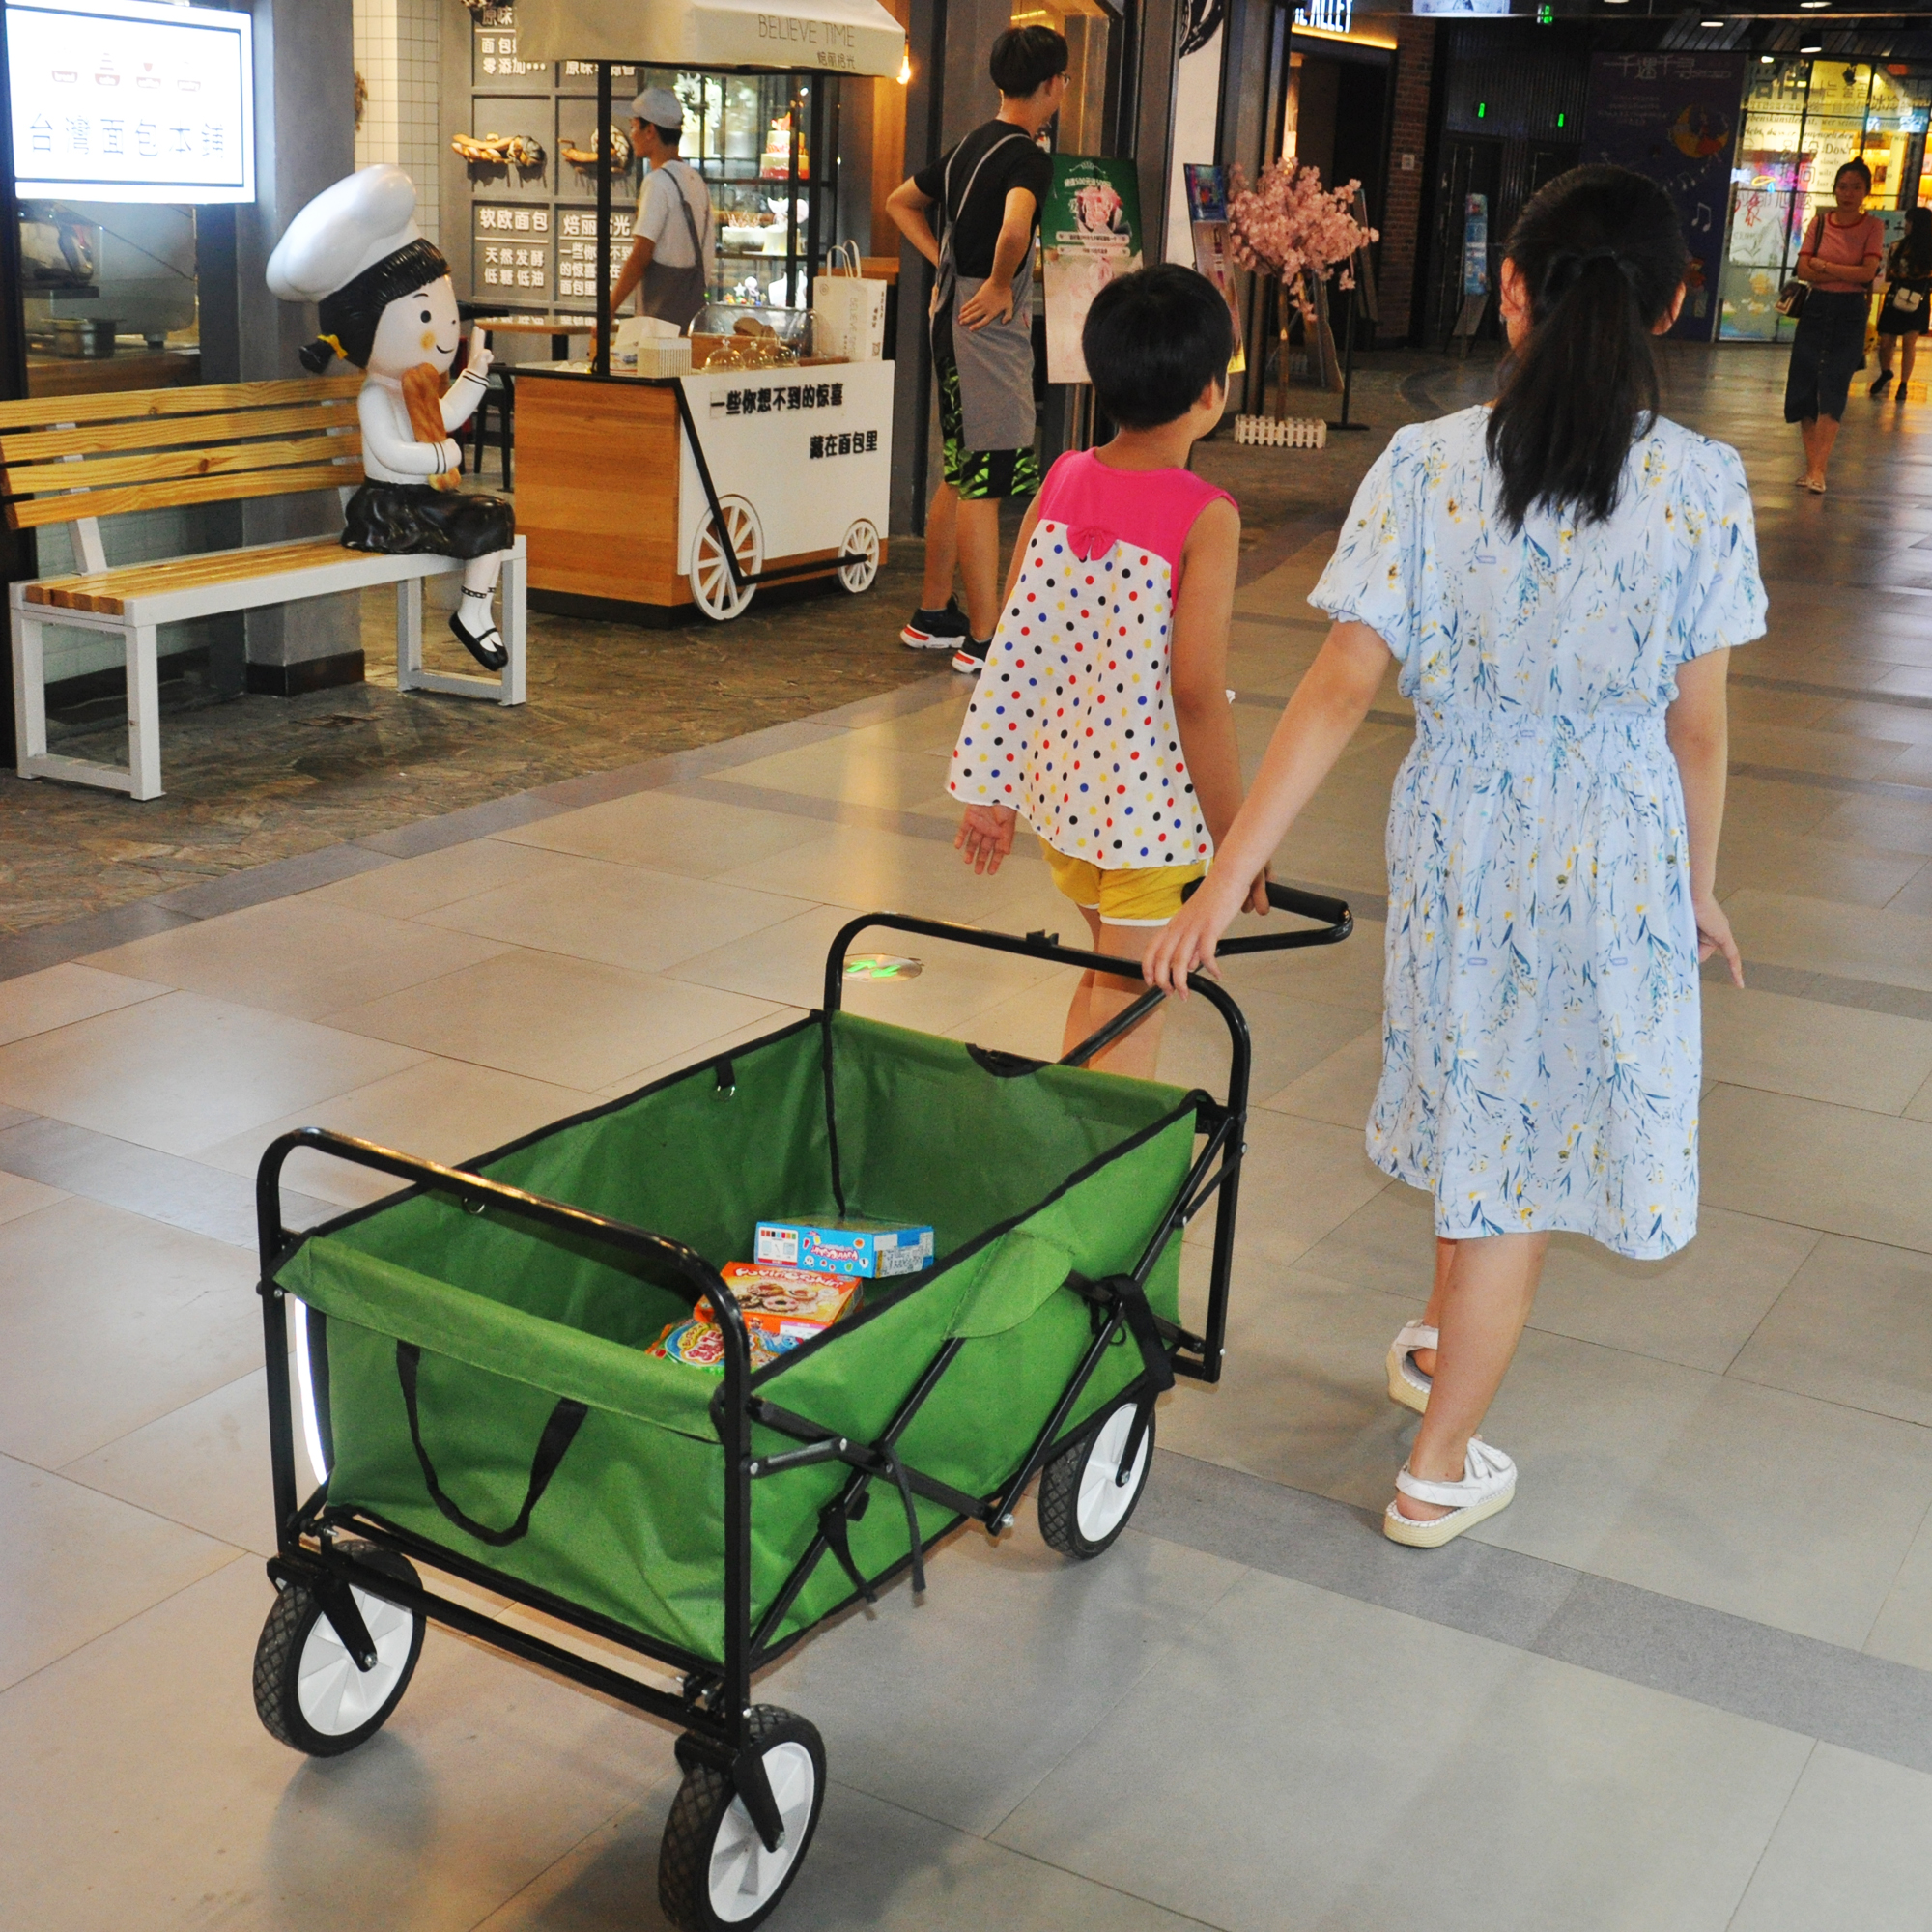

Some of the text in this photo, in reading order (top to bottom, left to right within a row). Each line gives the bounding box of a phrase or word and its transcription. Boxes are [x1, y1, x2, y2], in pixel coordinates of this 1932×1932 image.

[758, 14, 855, 47] BELIEVE TIME
[481, 37, 517, 54] 面包
[479, 208, 548, 232] 软欧面包
[563, 214, 631, 236] 焙丽光
[485, 247, 544, 268] 天然发酵
[559, 242, 634, 261] 一些你不到
[484, 268, 544, 287] 低糖低油
[559, 261, 622, 279] 的惊喜在
[710, 383, 843, 415] 一些你想不到的惊喜
[810, 430, 878, 460] 藏在面包里
